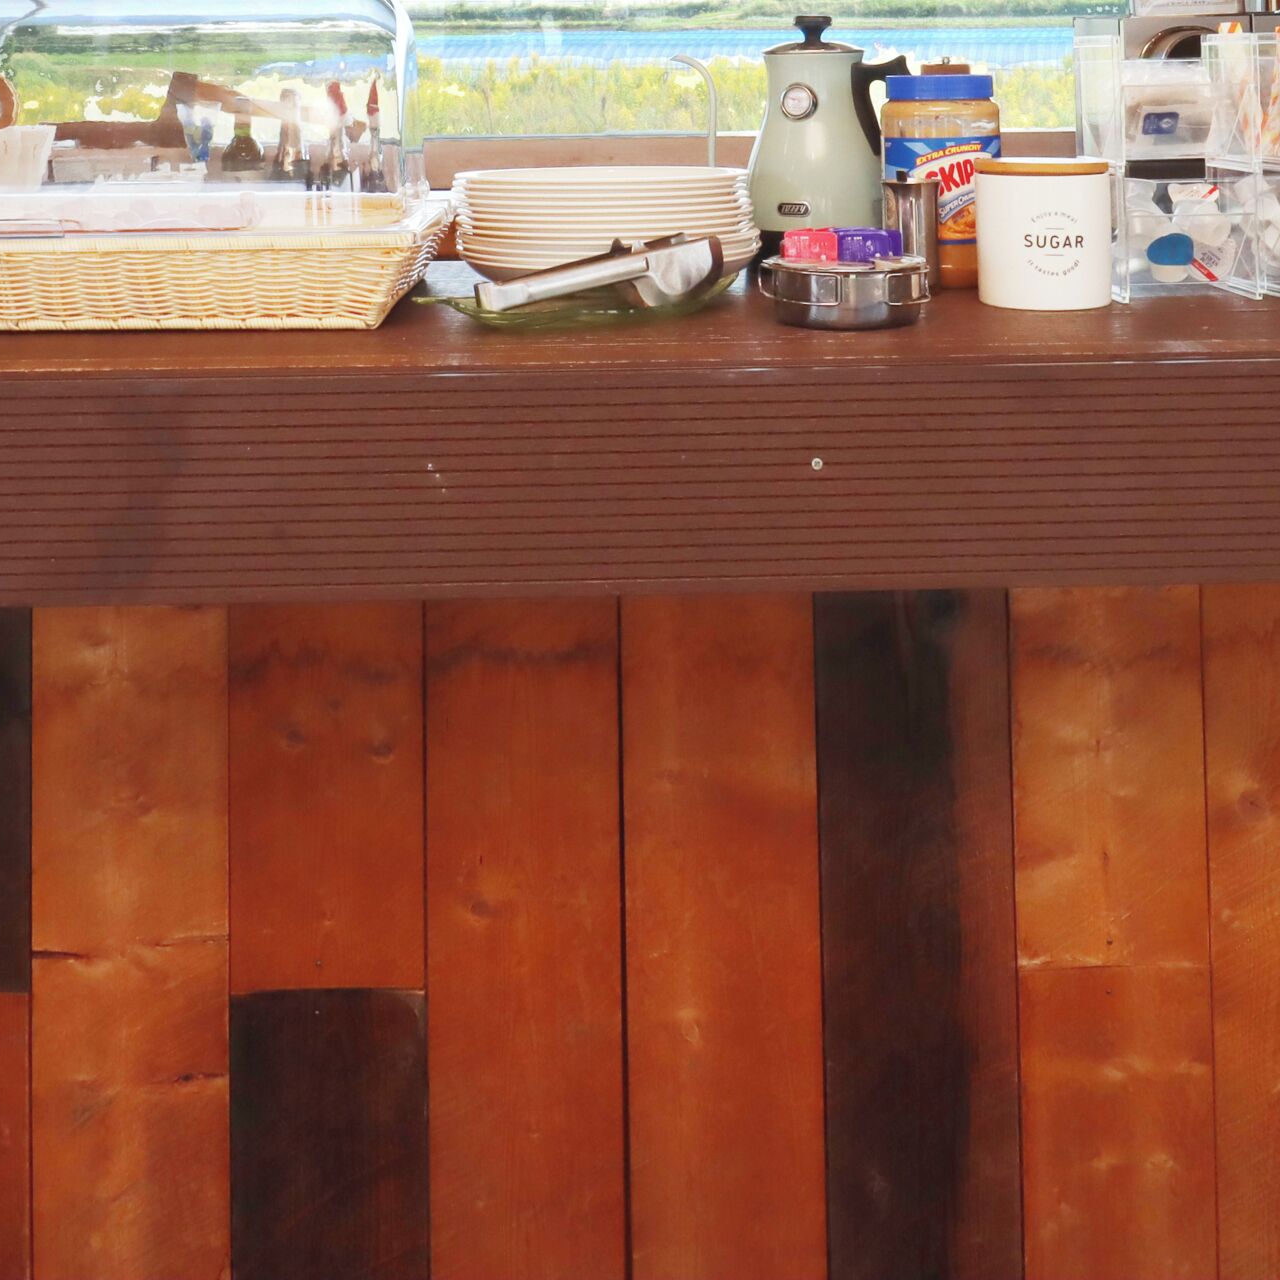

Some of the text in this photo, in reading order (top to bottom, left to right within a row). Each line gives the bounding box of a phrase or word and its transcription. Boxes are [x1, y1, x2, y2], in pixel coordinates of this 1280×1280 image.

[915, 143, 984, 167] EXTRA CRUNCHY
[925, 159, 976, 197] SKIP
[1023, 234, 1084, 249] SUGAR
